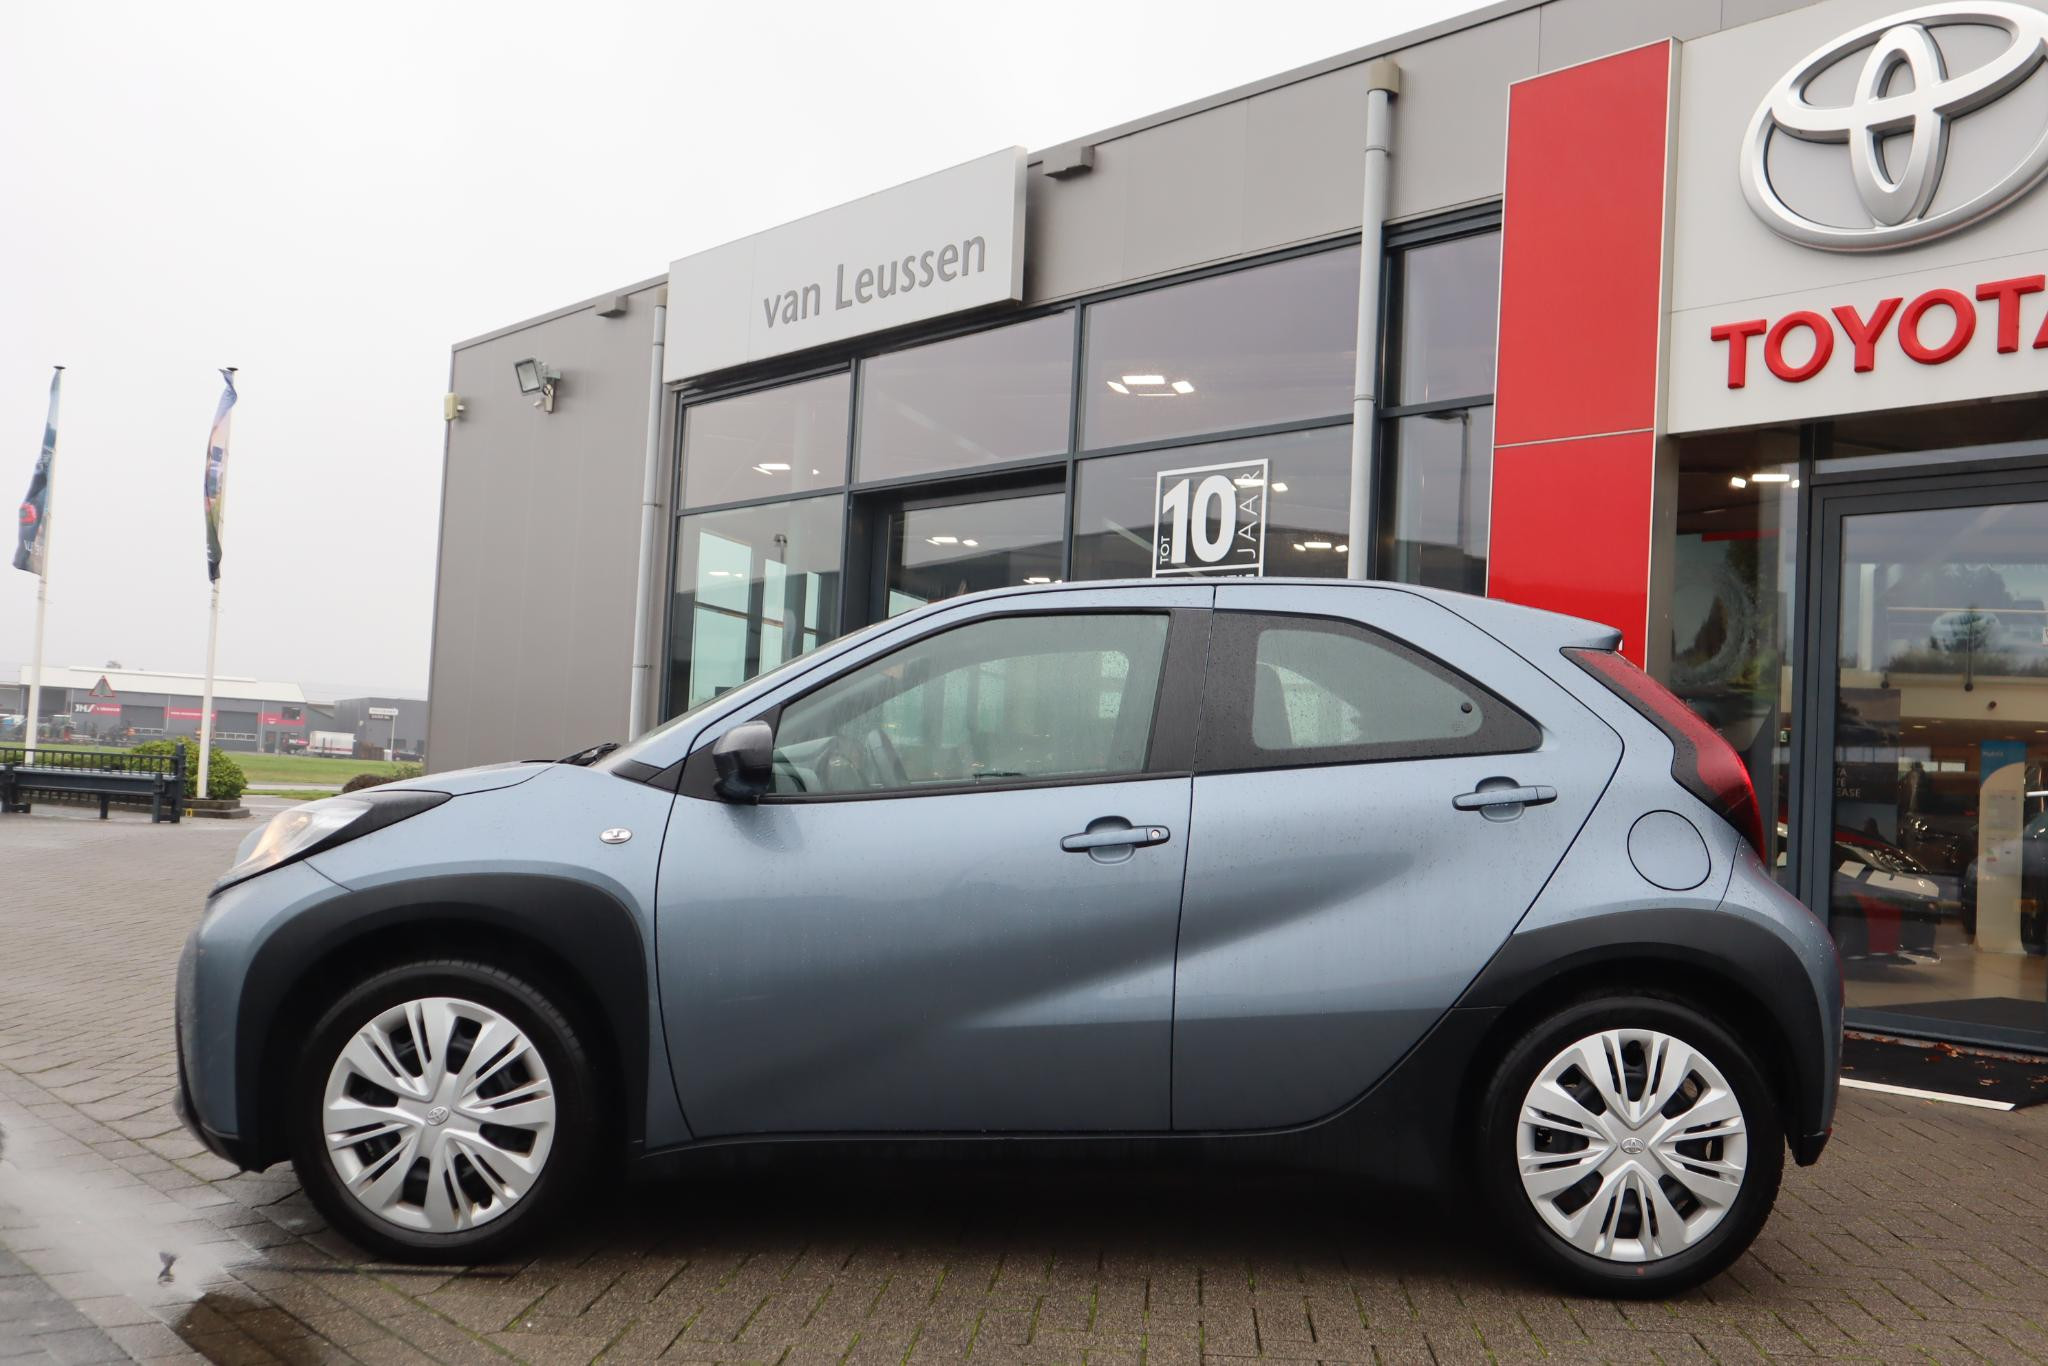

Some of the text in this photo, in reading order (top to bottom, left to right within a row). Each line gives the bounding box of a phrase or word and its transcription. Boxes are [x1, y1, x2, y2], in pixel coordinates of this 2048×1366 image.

[763, 234, 987, 329] van Leussen
[1159, 535, 1171, 565] TOT
[1162, 474, 1237, 564] 10
[1237, 469, 1261, 560] JAAR
